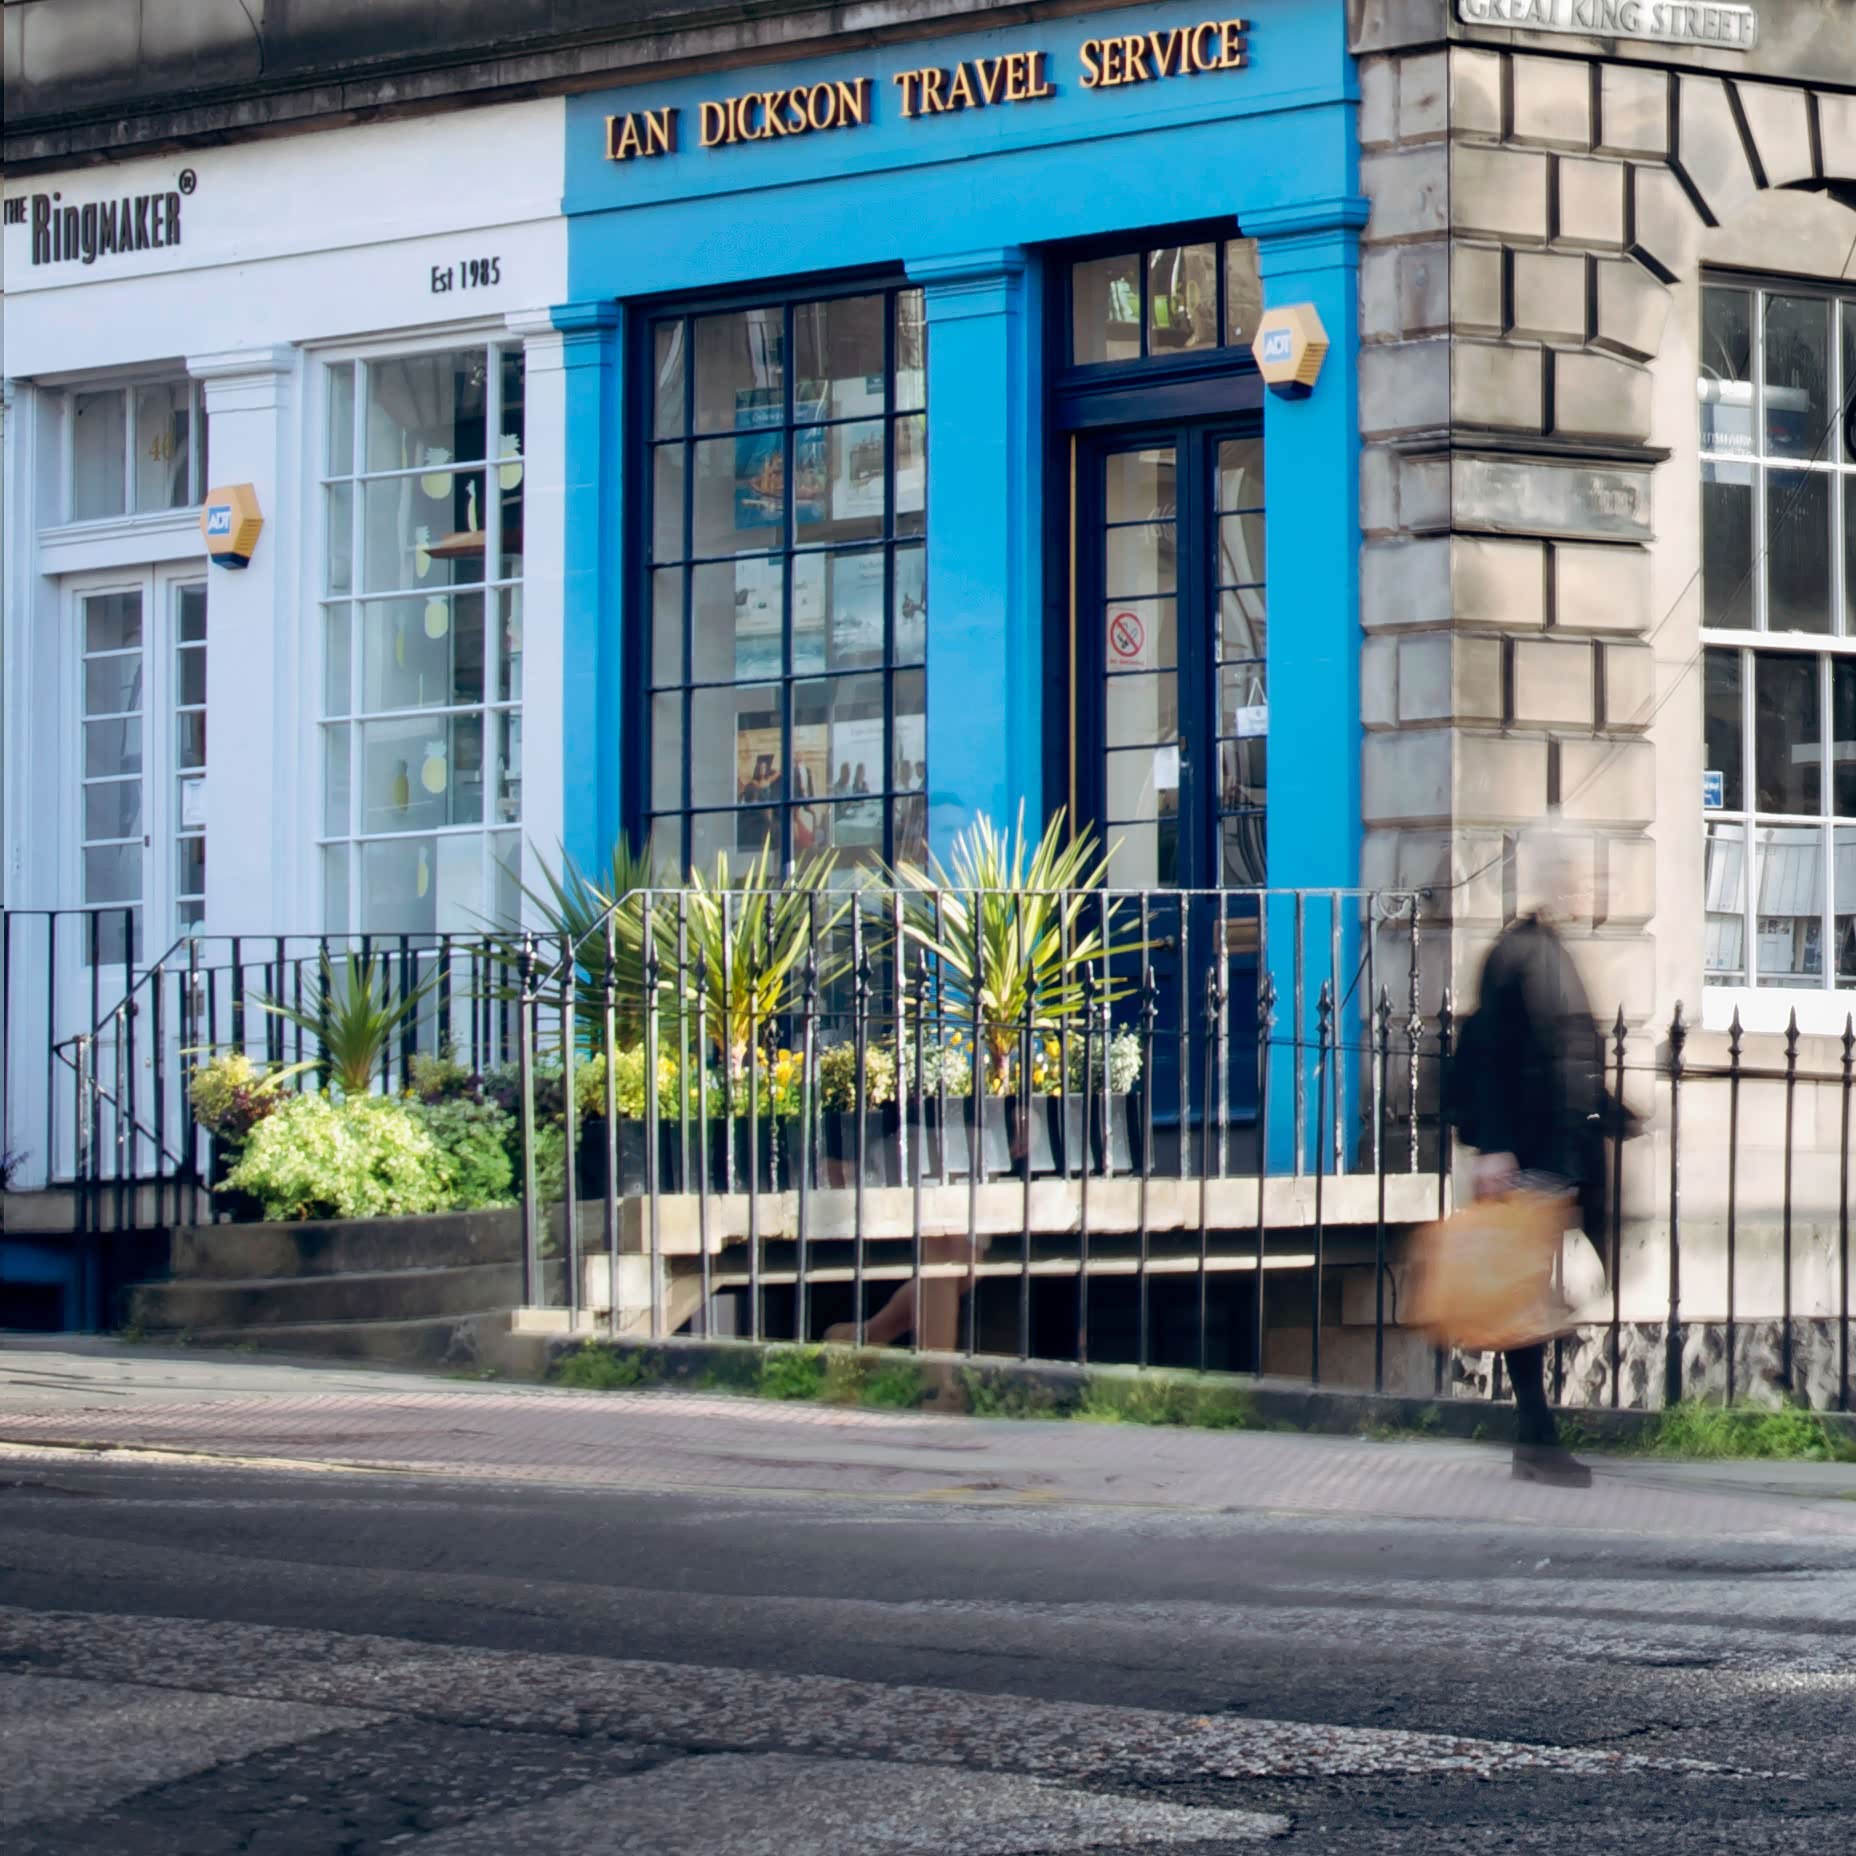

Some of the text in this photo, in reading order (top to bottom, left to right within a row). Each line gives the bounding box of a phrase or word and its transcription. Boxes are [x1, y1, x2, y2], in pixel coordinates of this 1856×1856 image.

[1650, 2, 1751, 42] STREET
[605, 18, 1247, 161] IAN DICKSON TRAVEL SERVICE
[430, 256, 501, 294] Est 1985
[1264, 335, 1290, 354] ADT
[208, 511, 231, 530] ADT
